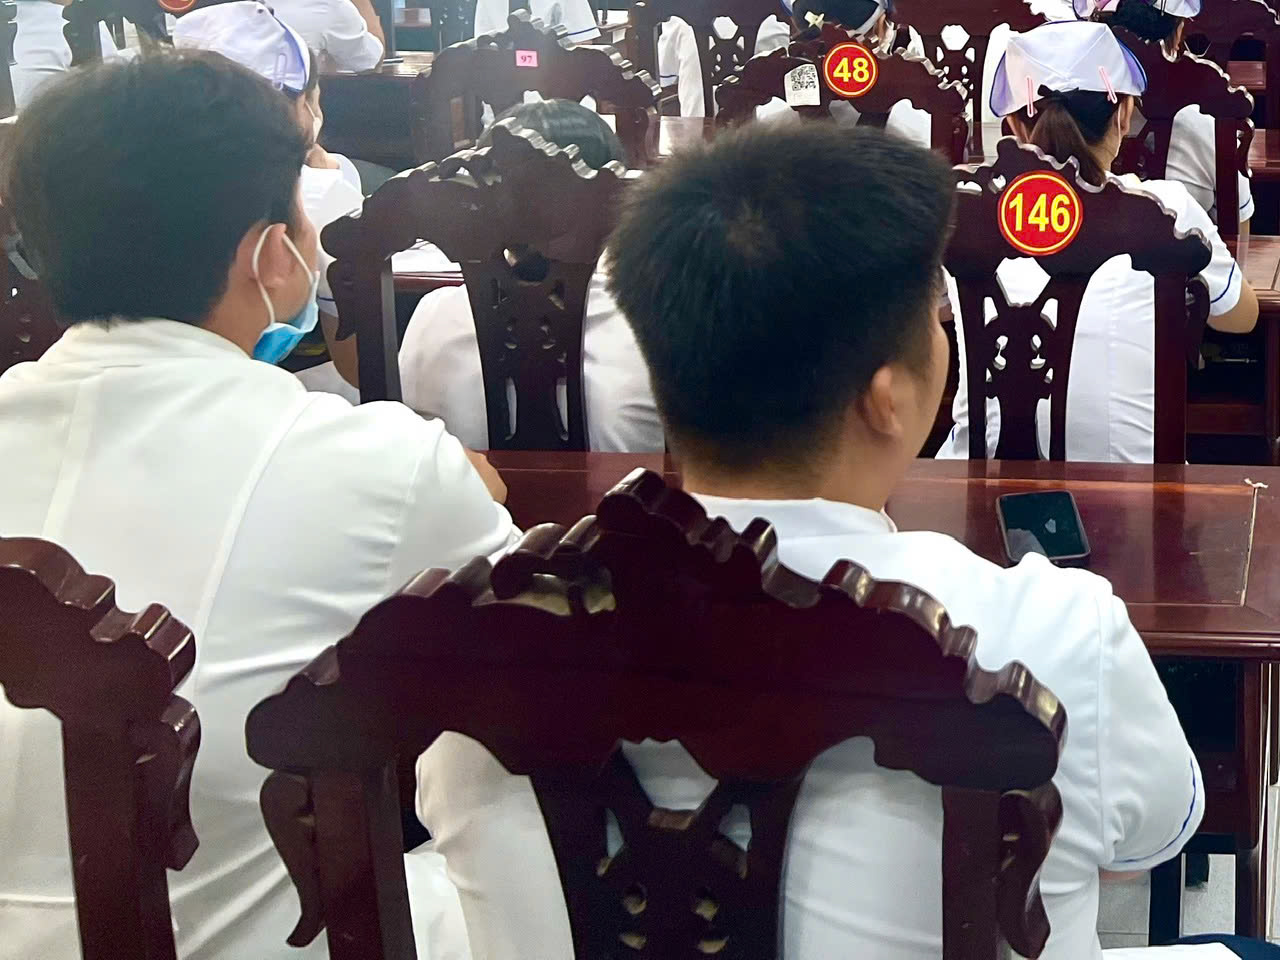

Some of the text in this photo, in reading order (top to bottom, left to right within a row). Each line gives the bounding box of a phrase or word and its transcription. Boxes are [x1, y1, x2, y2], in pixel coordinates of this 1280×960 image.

[520, 55, 532, 64] 97
[833, 57, 869, 83] 48
[1009, 193, 1071, 233] 146
